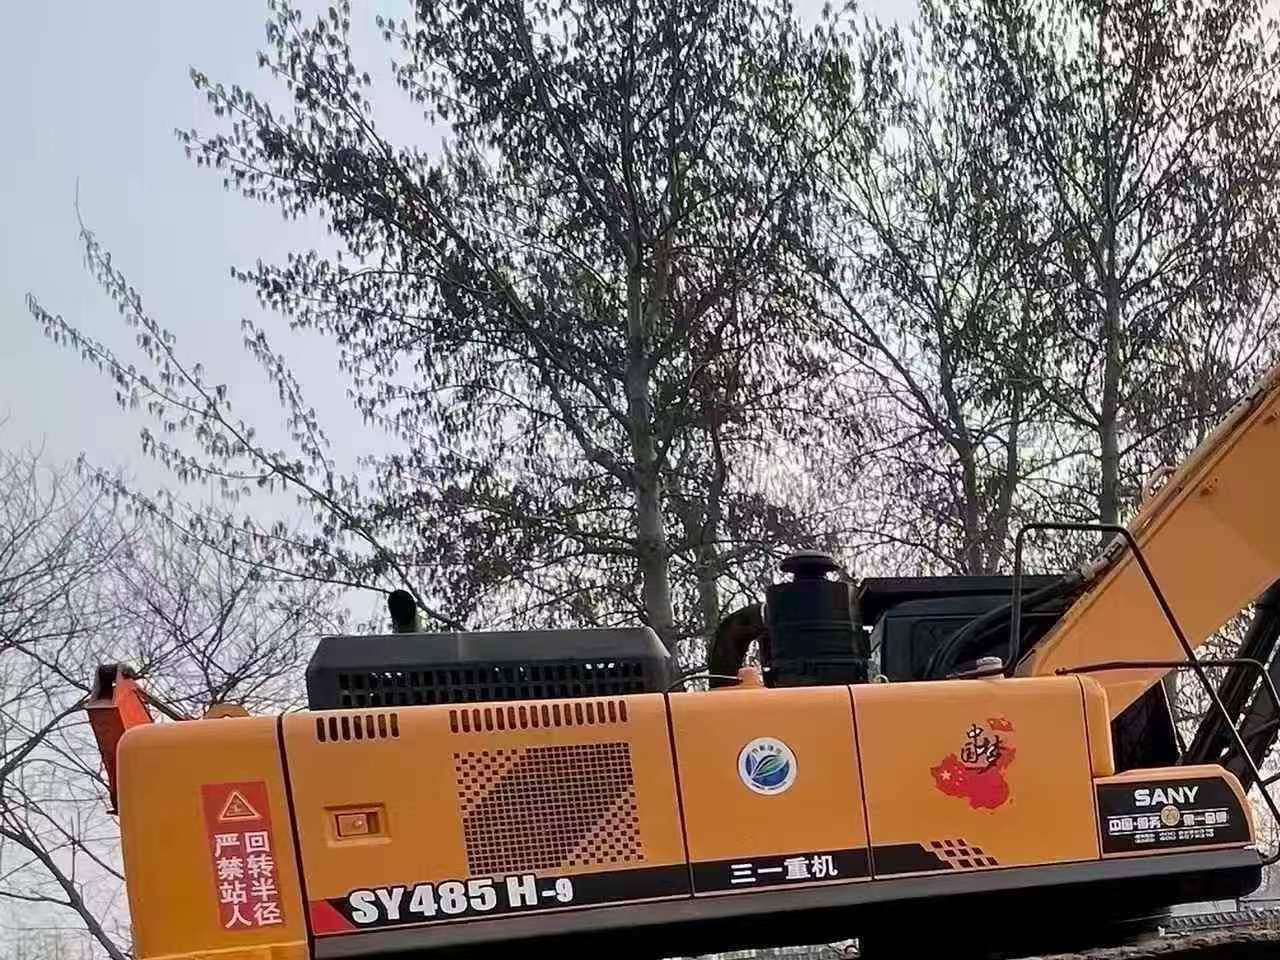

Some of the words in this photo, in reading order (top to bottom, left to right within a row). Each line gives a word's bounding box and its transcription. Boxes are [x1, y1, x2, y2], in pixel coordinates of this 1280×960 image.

[1134, 786, 1199, 807] SANY
[214, 833, 253, 929] 严禁站人
[244, 831, 283, 926] 回转半径
[730, 855, 838, 884] 三一重机
[349, 877, 497, 924] SY485
